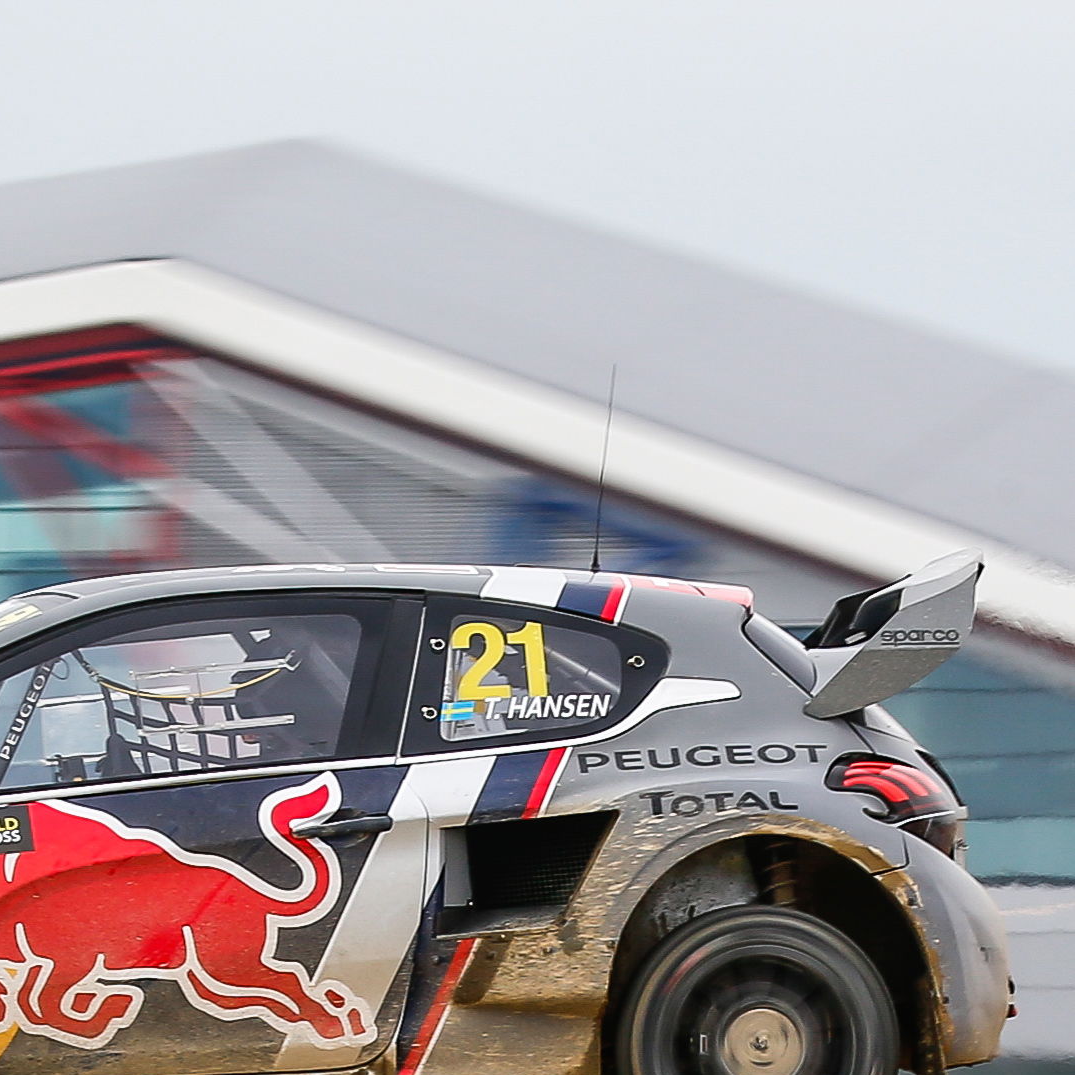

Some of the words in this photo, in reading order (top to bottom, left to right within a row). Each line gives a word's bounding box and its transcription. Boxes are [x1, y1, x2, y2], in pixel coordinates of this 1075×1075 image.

[880, 629, 960, 647] sparco
[451, 621, 549, 701] 21
[484, 697, 501, 720] T.
[507, 694, 611, 720] HANSEN
[577, 743, 827, 774] PEUGEOT
[640, 789, 799, 817] TOTAL
